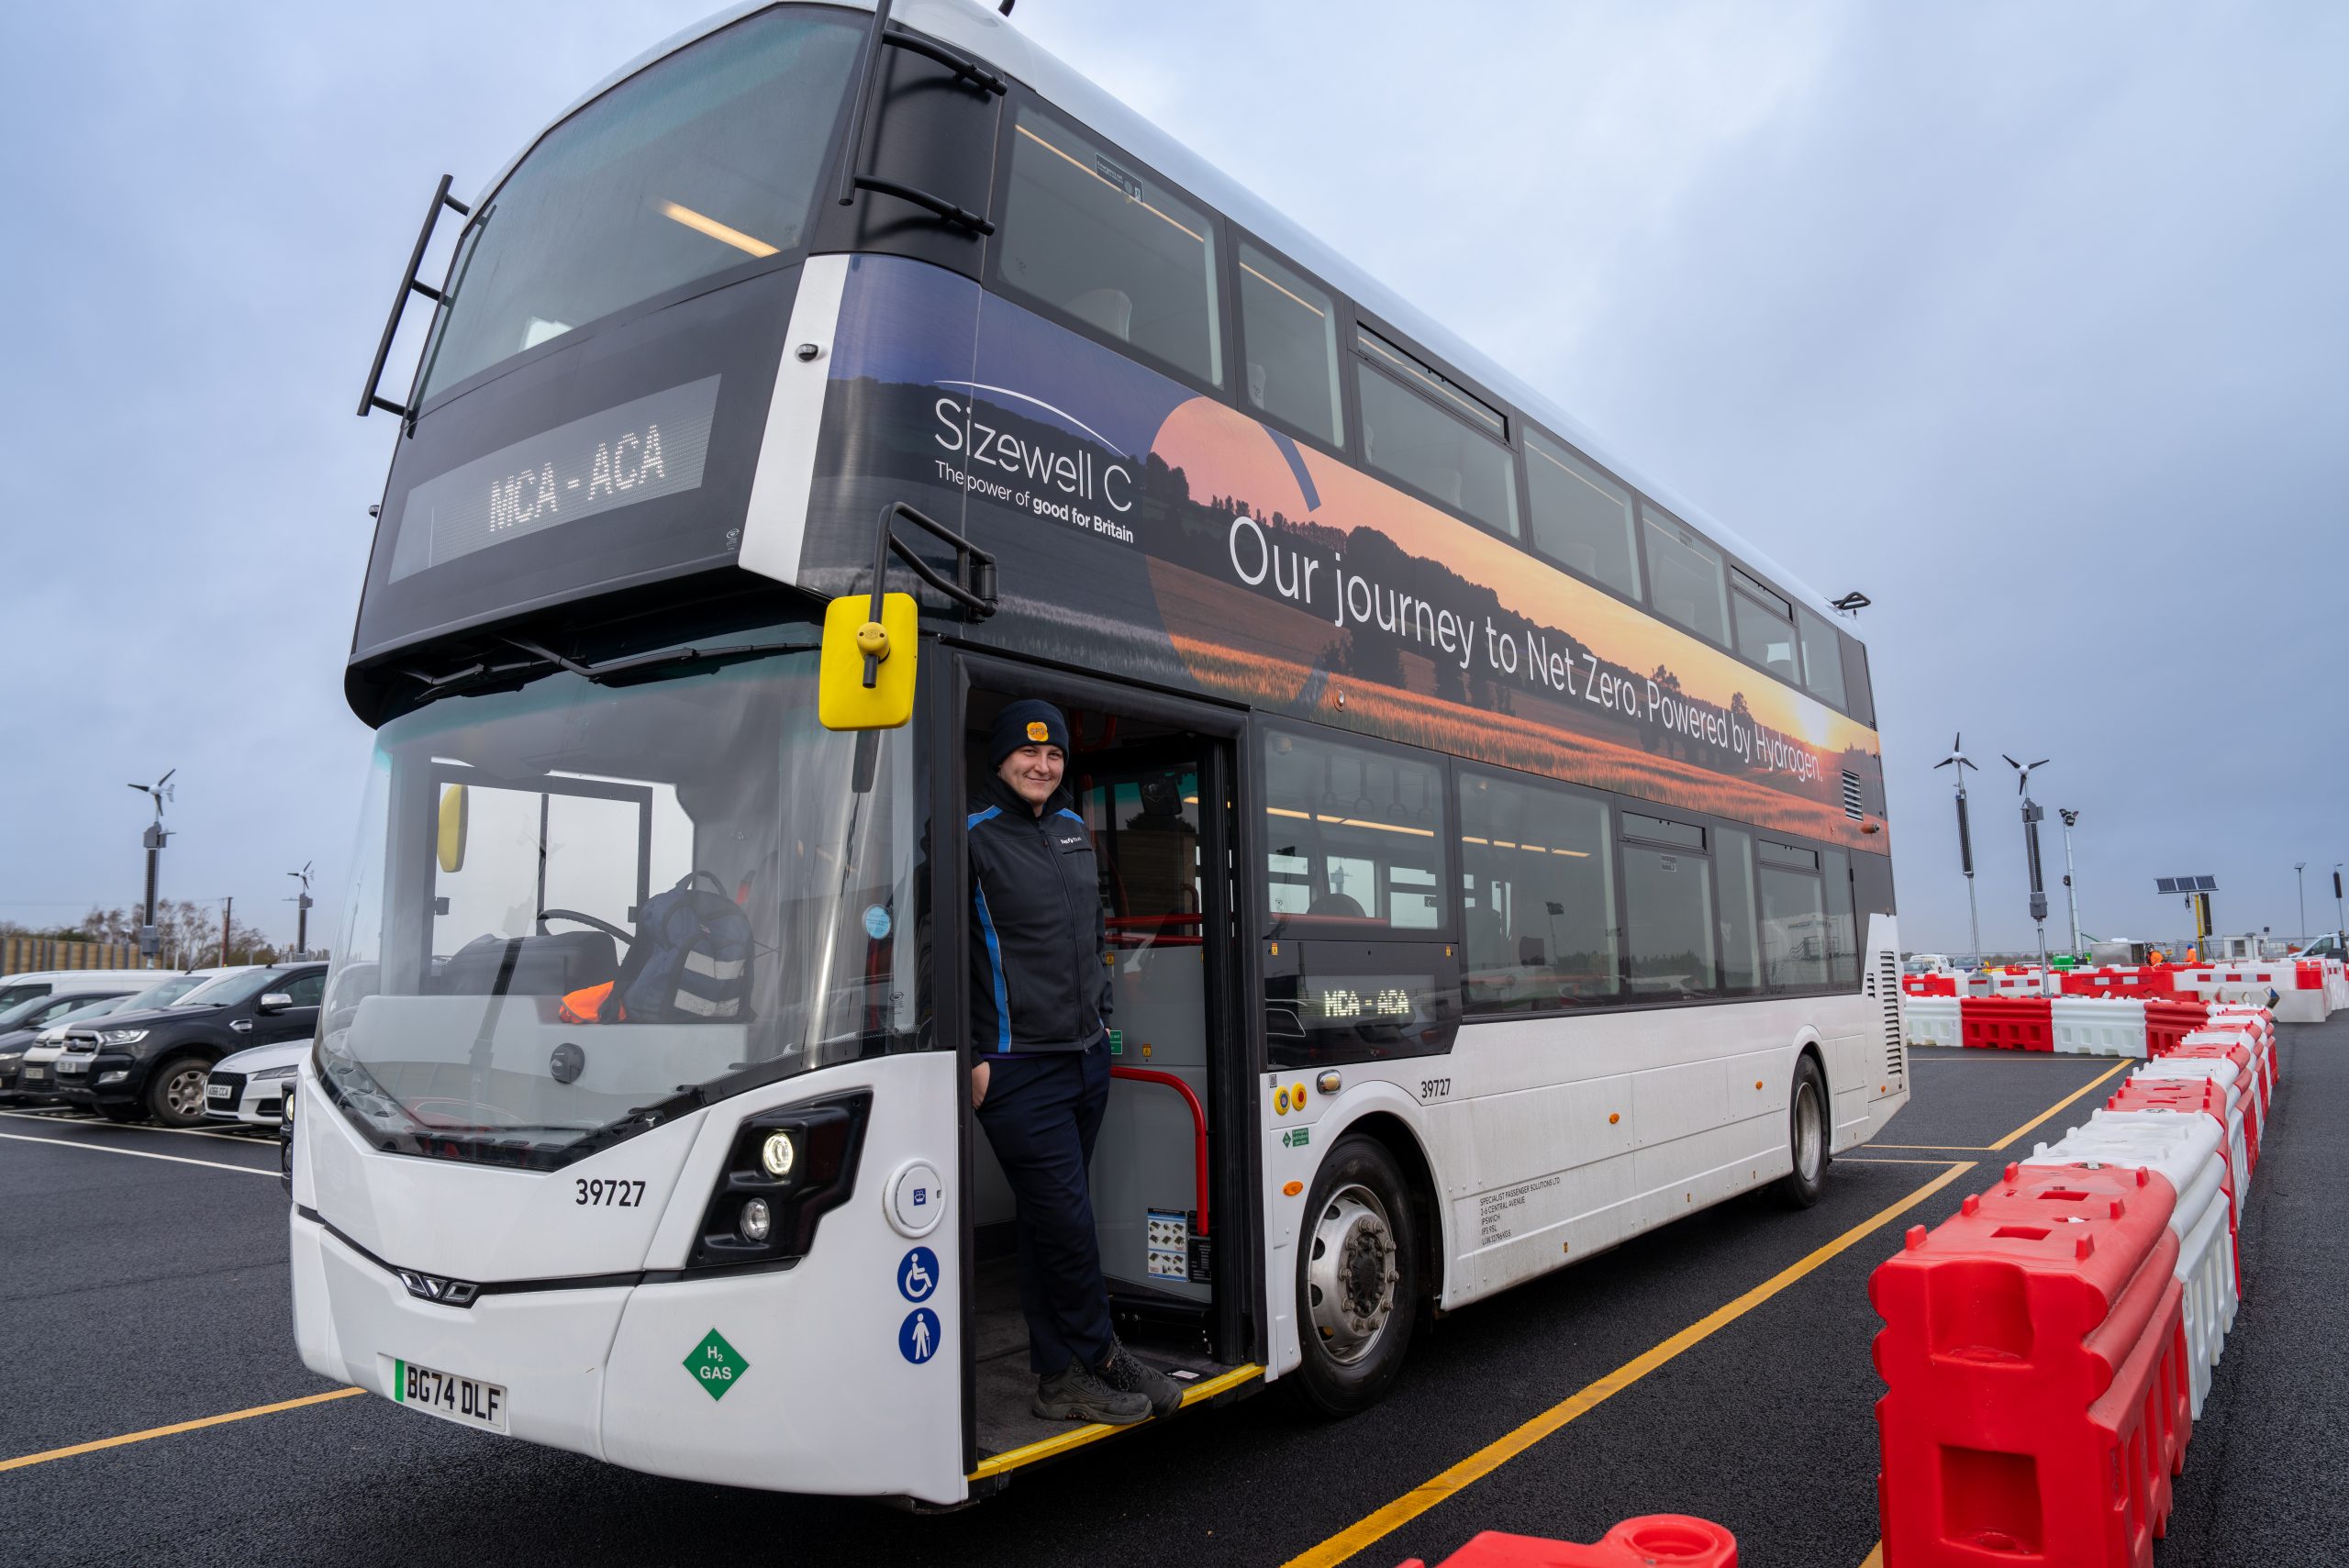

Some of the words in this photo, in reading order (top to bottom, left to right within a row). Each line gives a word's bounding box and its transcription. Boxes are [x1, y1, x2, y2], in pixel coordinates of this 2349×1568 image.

[934, 398, 1093, 500] Sizewell
[1104, 464, 1132, 512] C
[490, 462, 558, 532] MCA
[587, 424, 665, 501] ACA
[935, 460, 964, 485] The
[966, 473, 1012, 501] power
[1015, 491, 1030, 507] of
[1033, 497, 1069, 521] good
[1072, 507, 1091, 528] for
[1094, 515, 1134, 544] Britain
[1230, 516, 1319, 604] Our
[1335, 551, 1475, 669] journey
[1486, 616, 1518, 673] to
[1527, 630, 1576, 695] Net
[1582, 653, 1642, 718] Zero.
[1647, 680, 1728, 749] Powered
[1731, 712, 1752, 763] by
[1755, 724, 1823, 783] Hydrogen.
[1325, 990, 1360, 1018] MCA
[1376, 989, 1409, 1015] ACA
[1421, 1078, 1452, 1099] 39727
[575, 1178, 646, 1207] 39727
[1480, 1193, 1505, 1207] SPECIALIST
[1505, 1185, 1530, 1198] PASSENGER
[1530, 1179, 1553, 1192] SOLUTIONS
[1488, 1201, 1508, 1214] CENTRAL
[1508, 1196, 1525, 1207] AVENUE
[1482, 1214, 1499, 1226] IPSWICH
[699, 1365, 732, 1381] GAS
[406, 1365, 456, 1410] BG74
[461, 1384, 501, 1421] DLF
